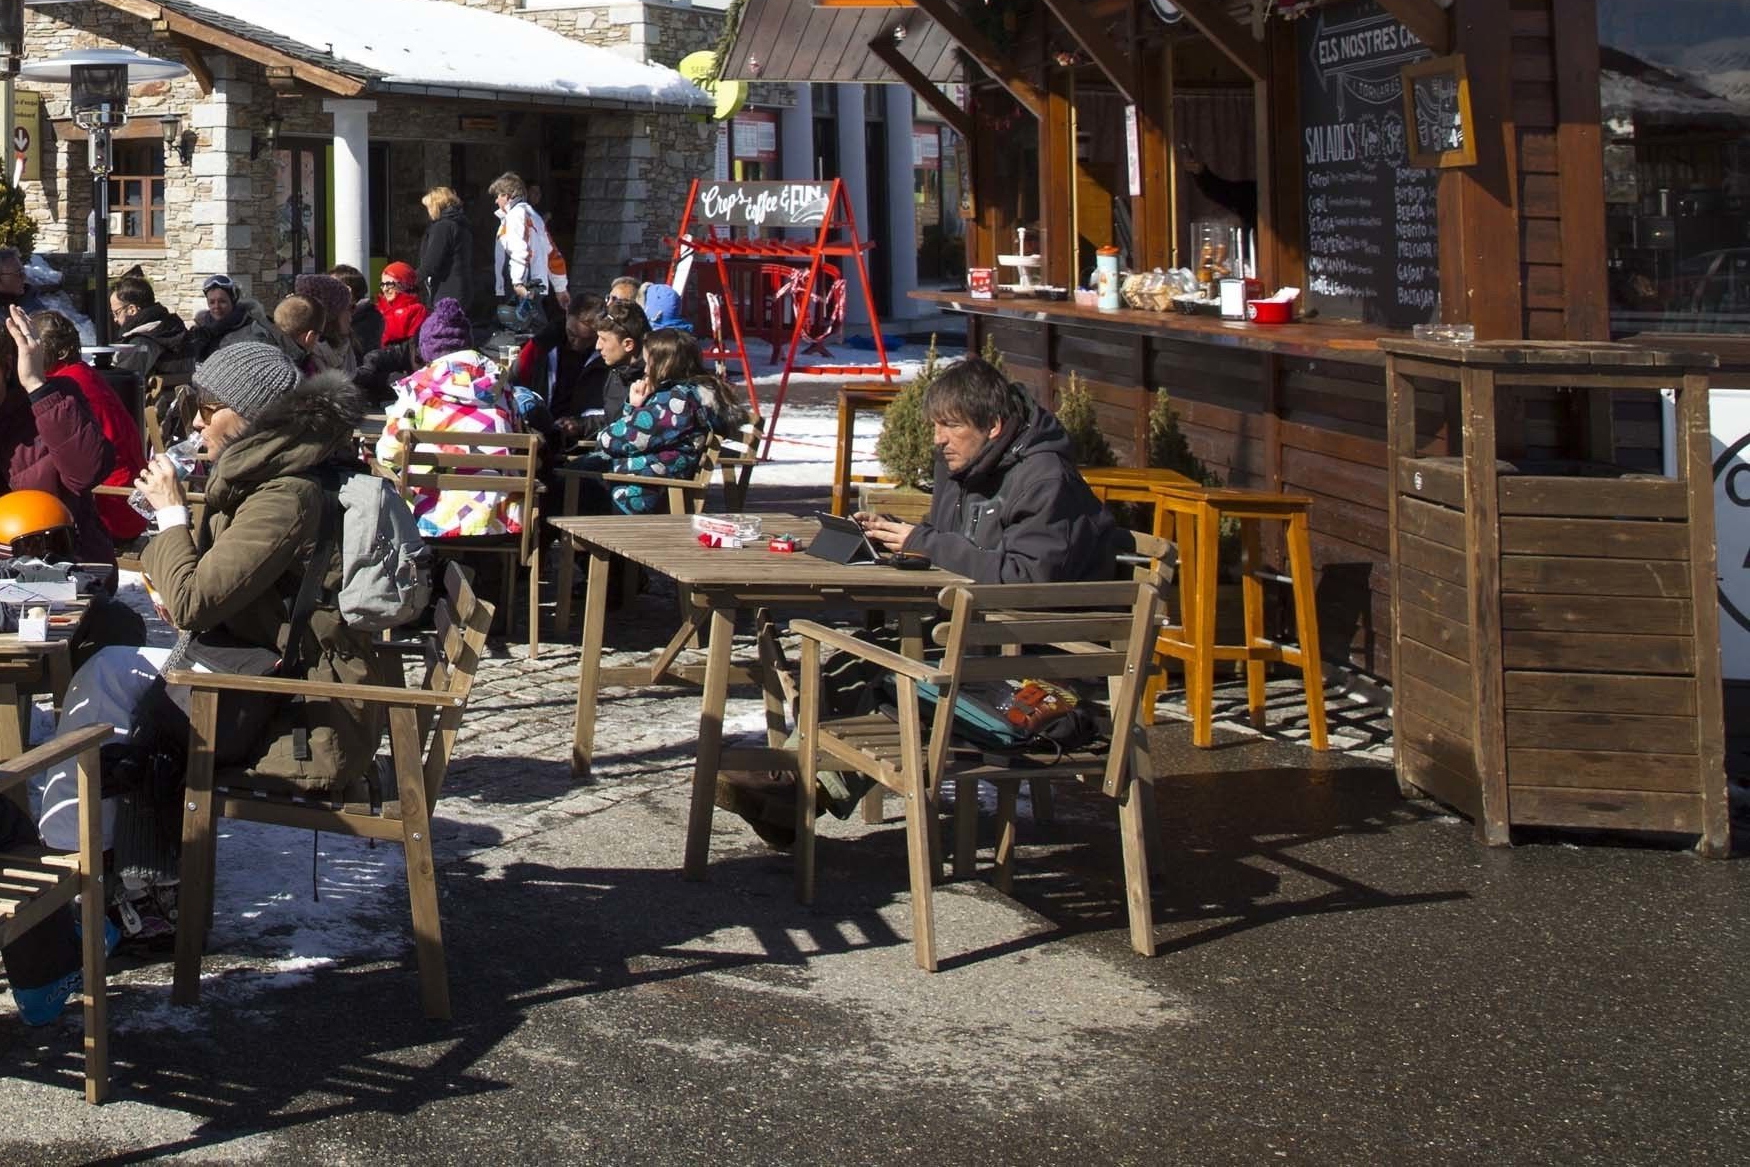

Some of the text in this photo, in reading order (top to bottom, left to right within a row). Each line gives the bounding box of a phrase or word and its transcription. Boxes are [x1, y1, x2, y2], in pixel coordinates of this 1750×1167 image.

[1319, 38, 1339, 65] ELS
[1340, 25, 1398, 58] NOSTRES
[1305, 123, 1355, 164] SALADES
